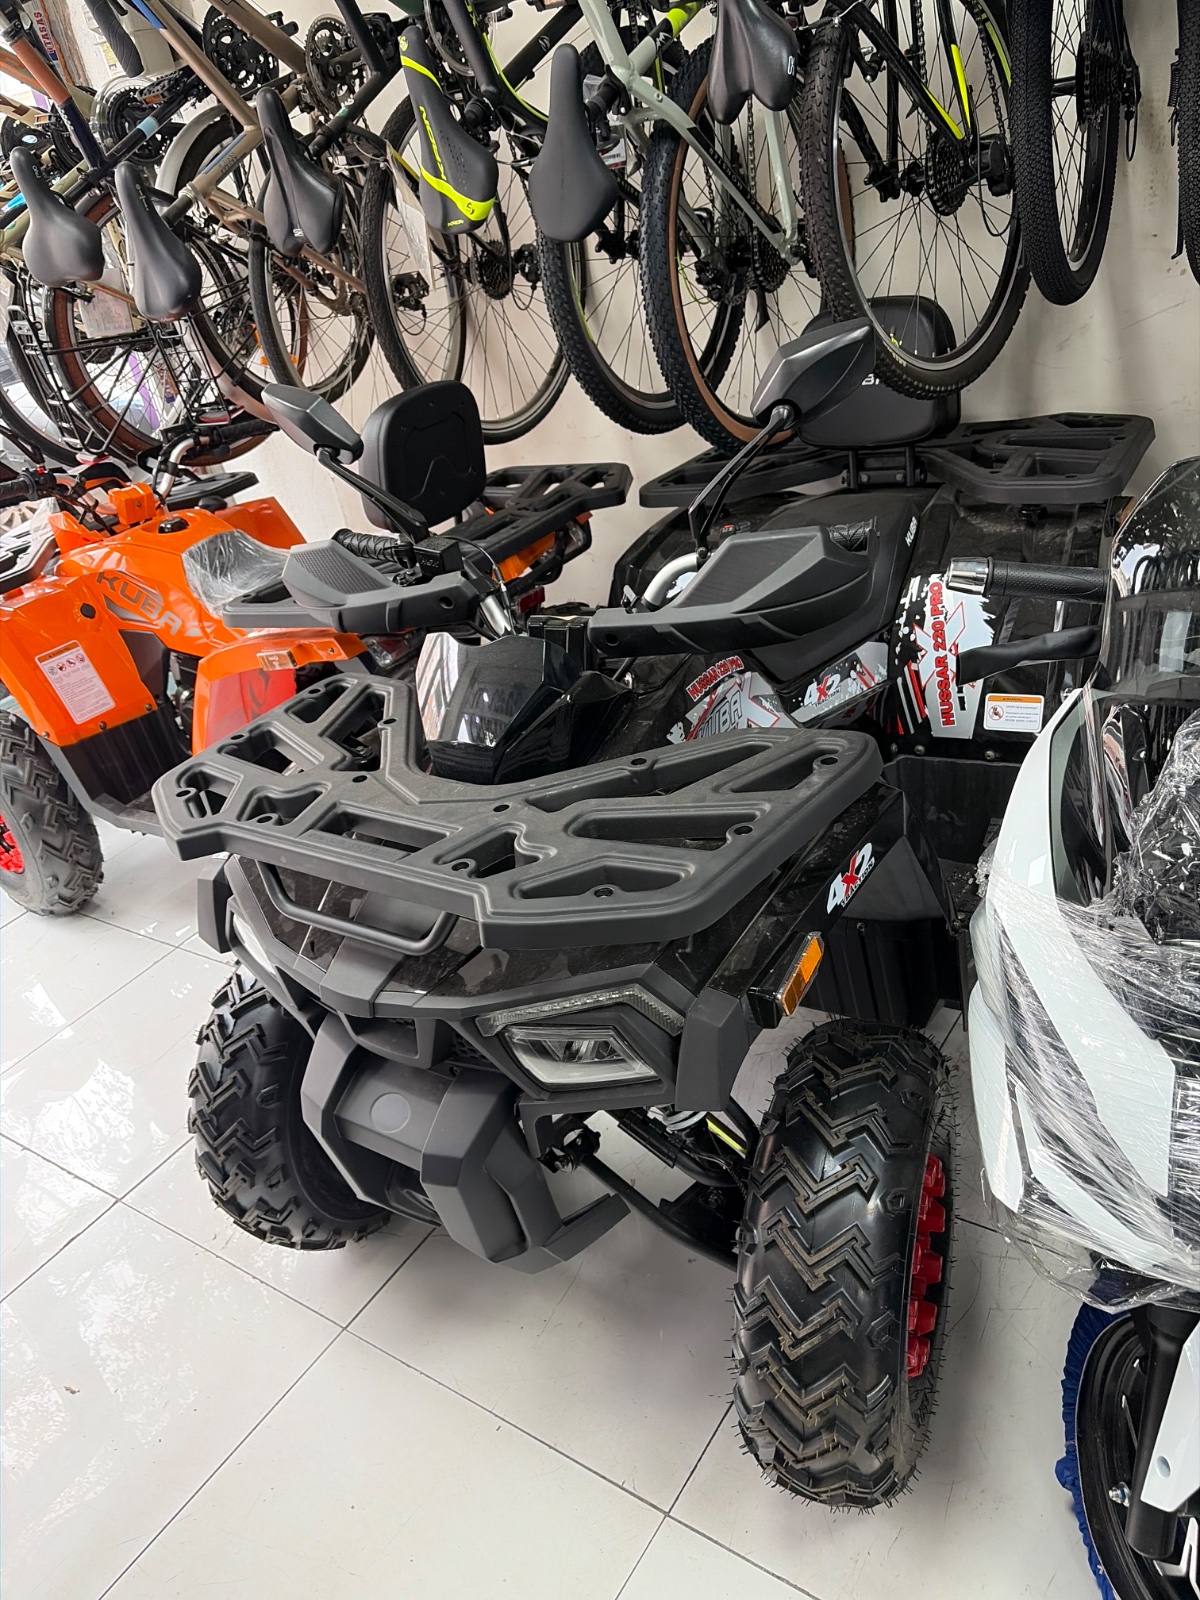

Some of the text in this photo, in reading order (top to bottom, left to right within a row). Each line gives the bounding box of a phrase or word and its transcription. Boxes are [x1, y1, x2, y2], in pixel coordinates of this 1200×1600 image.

[96, 571, 182, 636] KUBA
[686, 666, 720, 702] HUSSAR
[928, 581, 957, 727] HUSSAR 220 PRO
